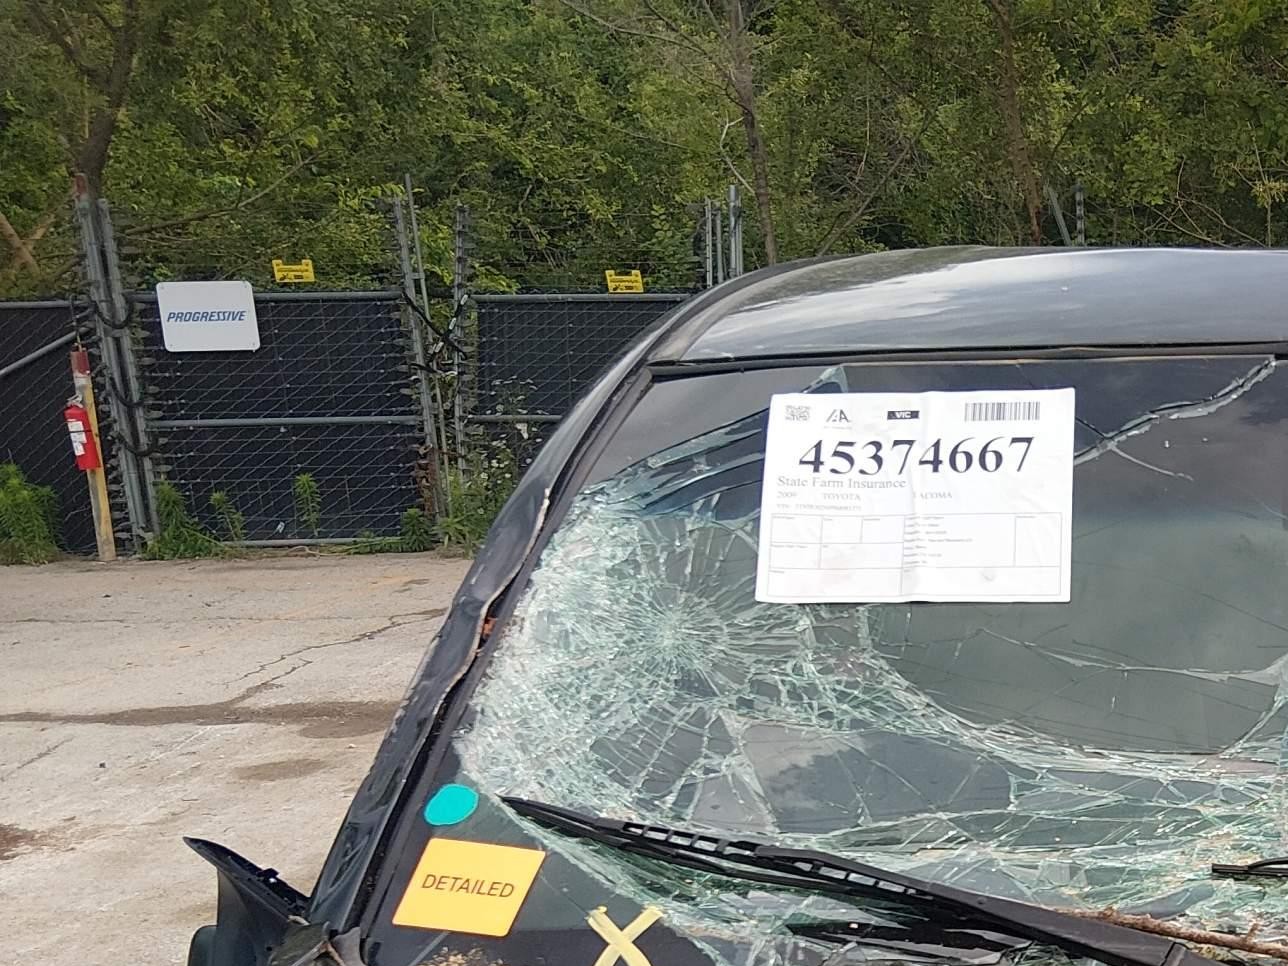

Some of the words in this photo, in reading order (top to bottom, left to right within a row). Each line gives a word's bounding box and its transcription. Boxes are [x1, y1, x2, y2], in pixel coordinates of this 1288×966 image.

[167, 310, 247, 322] PROGRESSIVE
[798, 436, 1035, 476] 45374667
[777, 475, 808, 488] State
[812, 476, 844, 488] Farm
[847, 478, 907, 489] Insurance
[823, 492, 862, 501] TOYOTA
[421, 873, 515, 898] DETAILED
